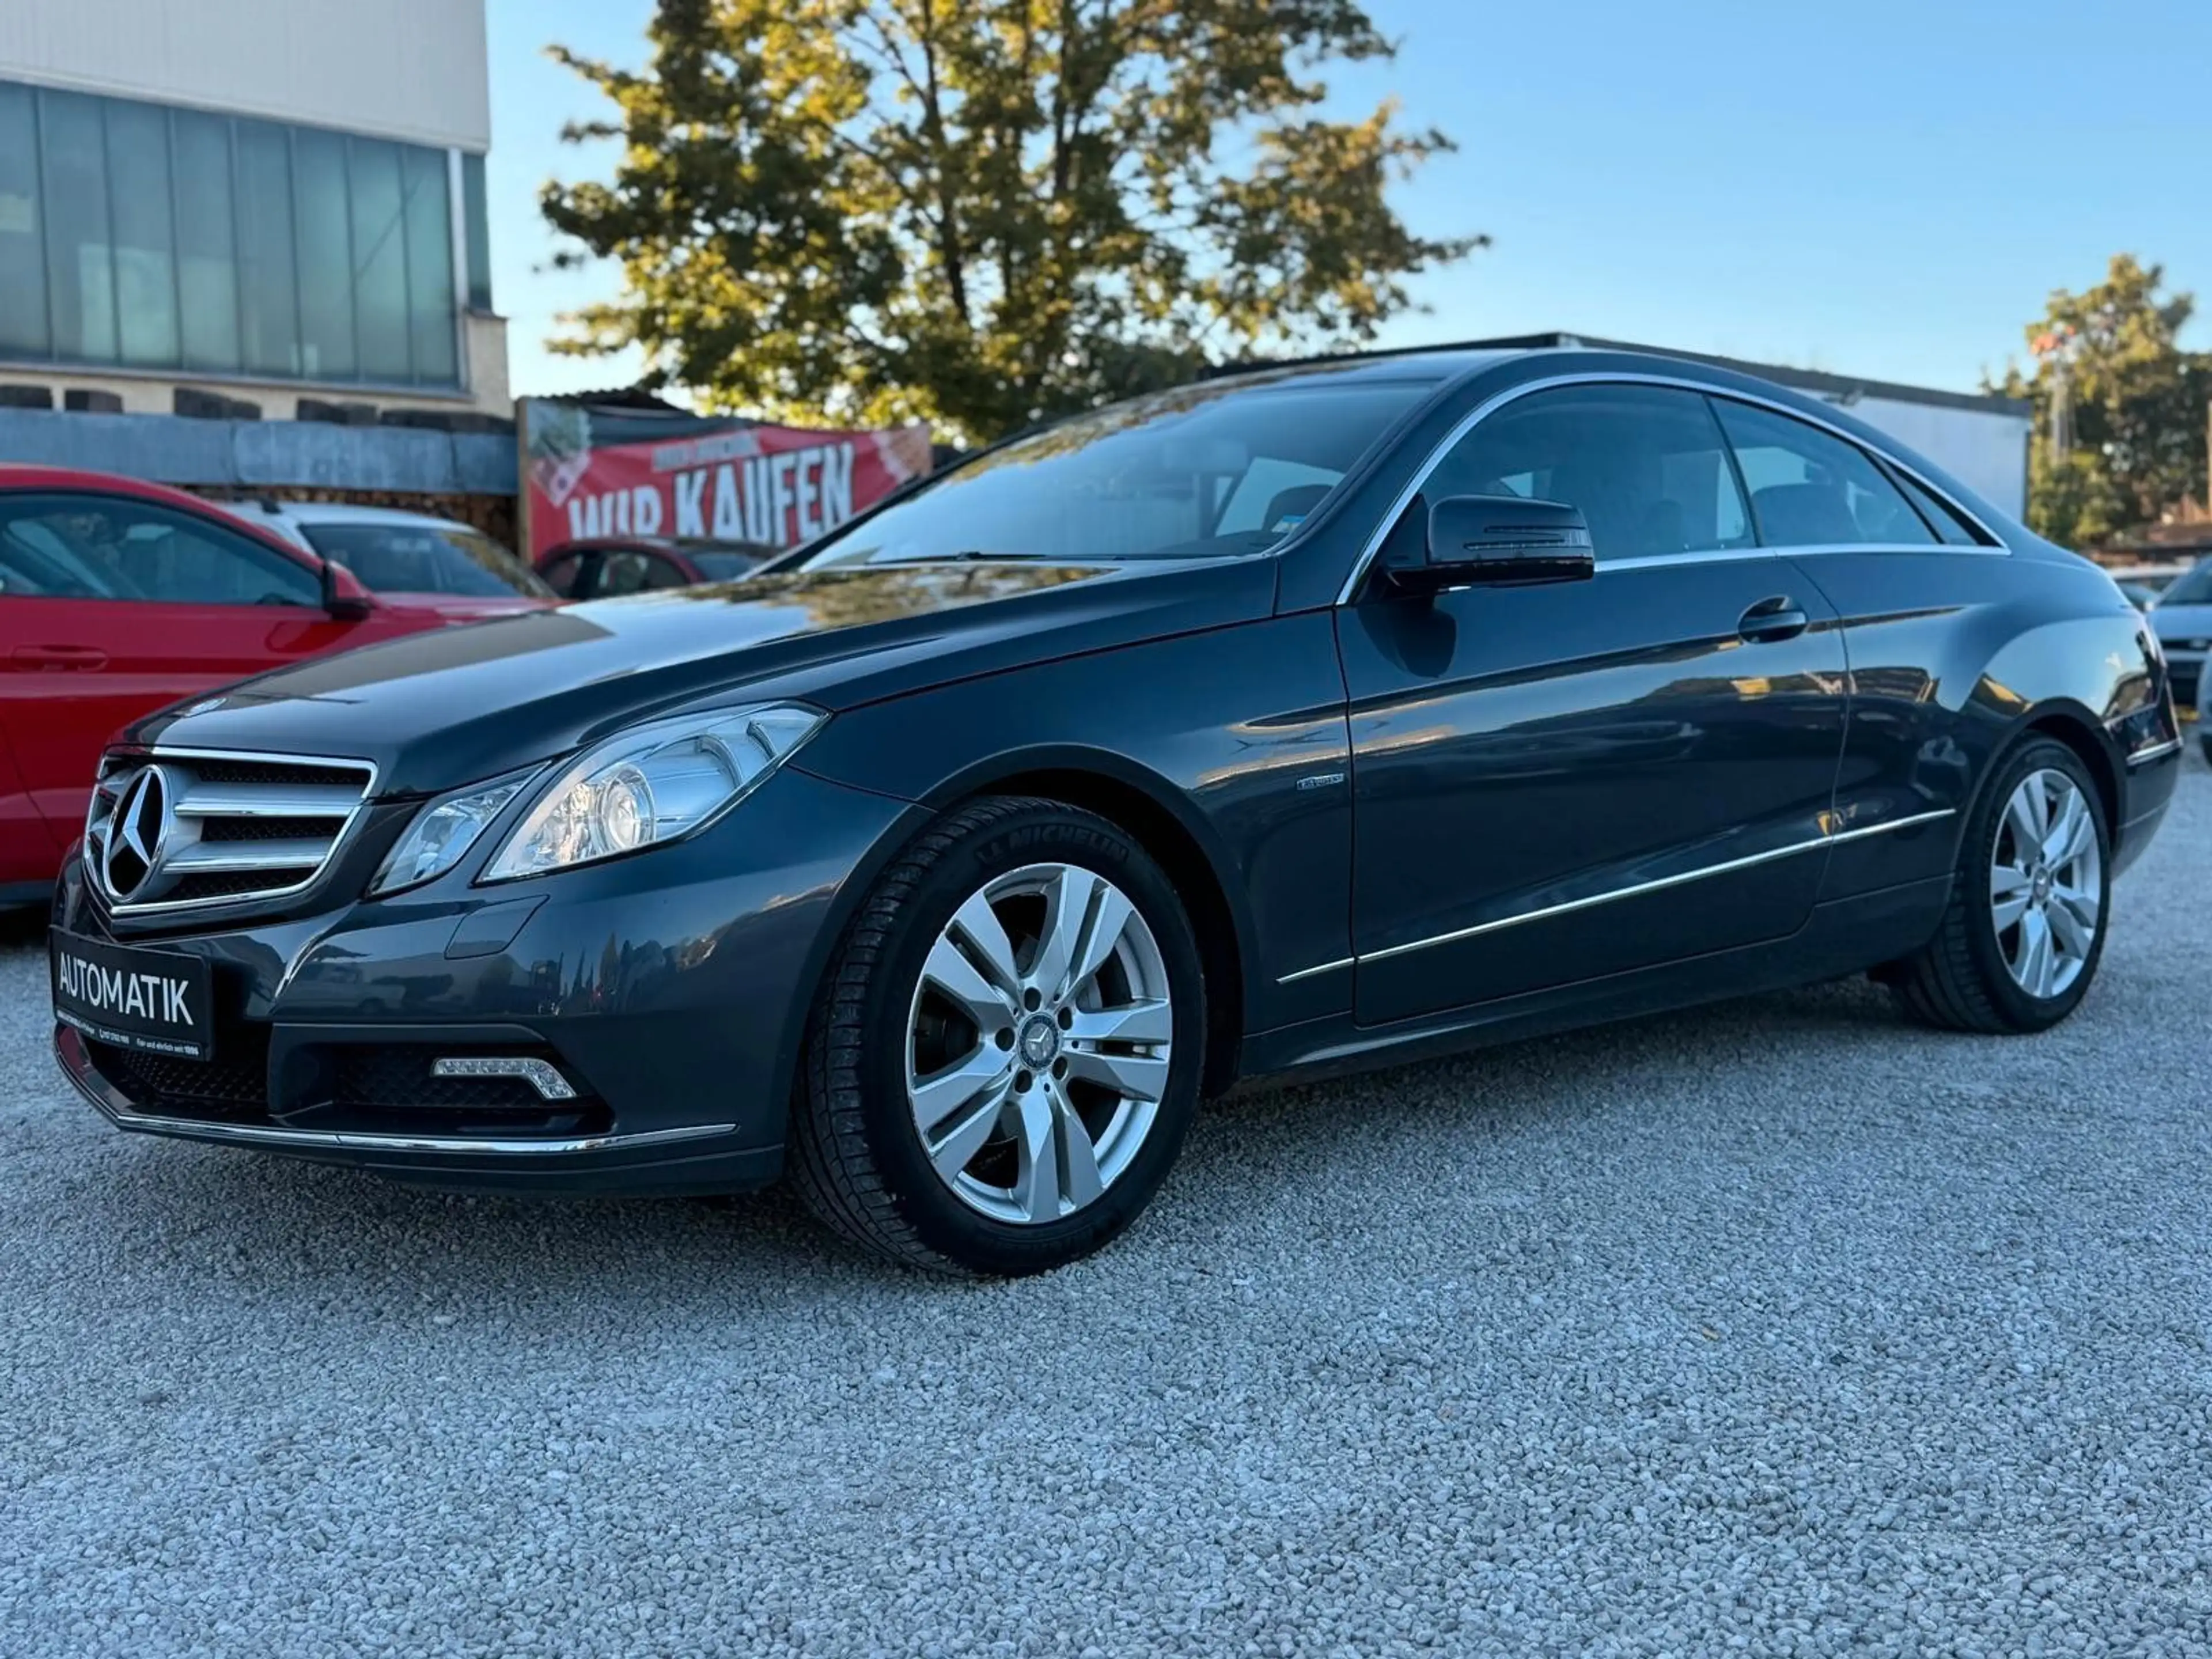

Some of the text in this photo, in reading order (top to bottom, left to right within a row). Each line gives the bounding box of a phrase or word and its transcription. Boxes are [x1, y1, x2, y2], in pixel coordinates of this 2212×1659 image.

[674, 441, 854, 547] KAUFEN
[1010, 824, 1128, 862] MICHELIN
[60, 952, 194, 1025] AUTOMATIK
